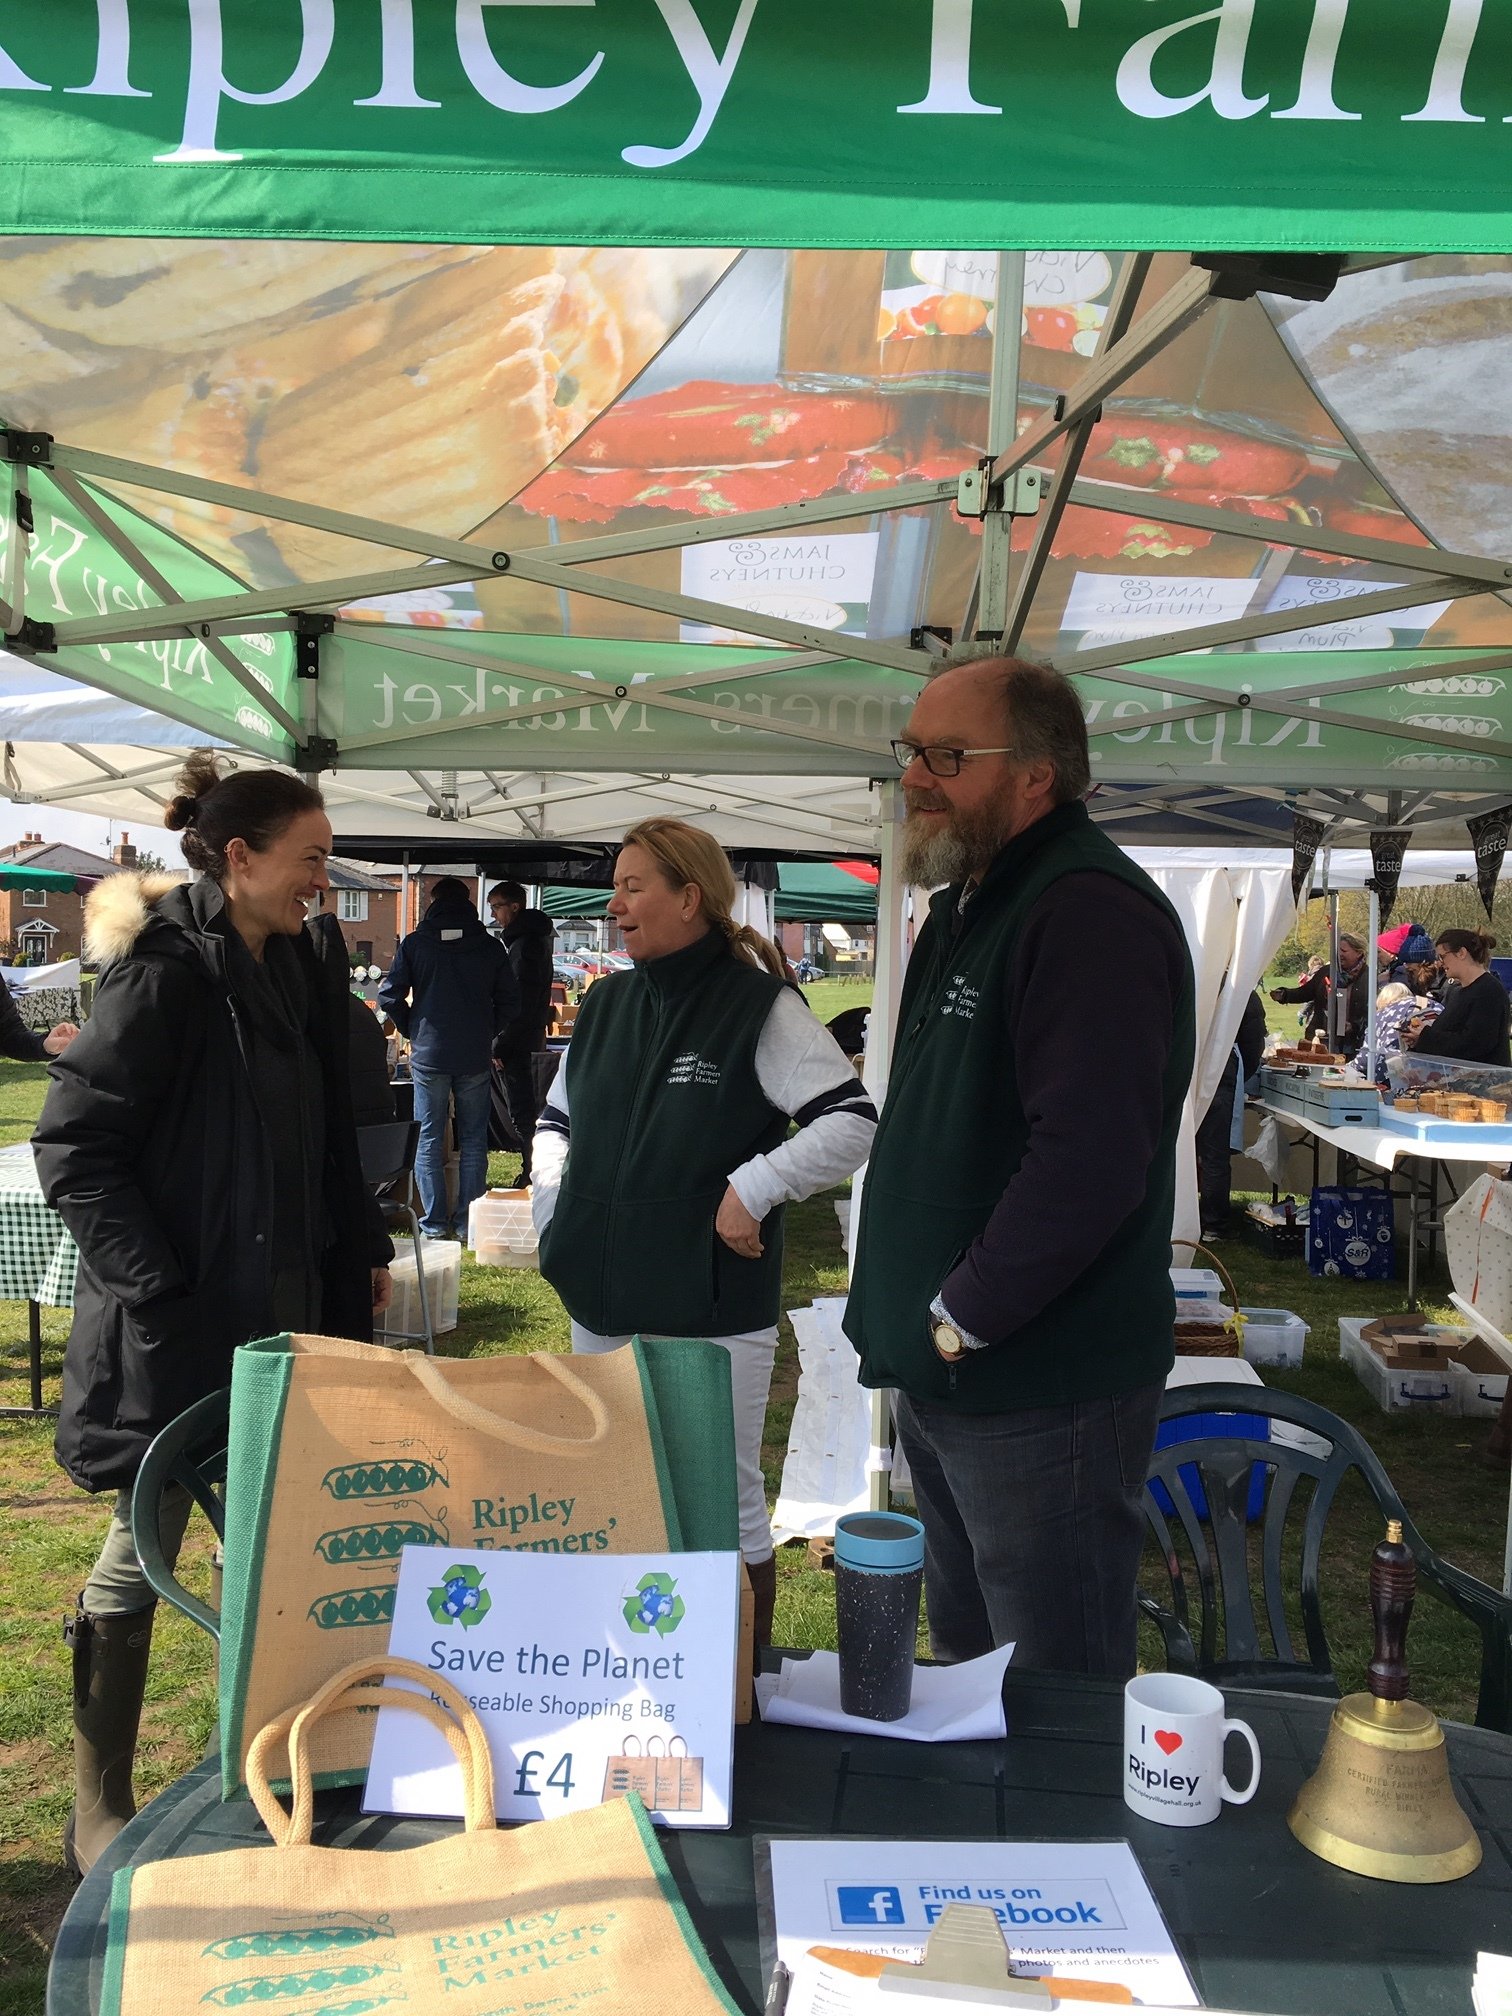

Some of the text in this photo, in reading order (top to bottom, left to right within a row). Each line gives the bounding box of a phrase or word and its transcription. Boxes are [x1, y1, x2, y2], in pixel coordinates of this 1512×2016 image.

[1295, 840, 1316, 857] taste
[1478, 838, 1507, 859] taste
[1376, 860, 1402, 872] taste
[697, 1060, 718, 1070] Ripley
[694, 1075, 718, 1085] Market
[472, 1493, 576, 1534] Ripley
[428, 1640, 685, 1679] Save the Planet
[430, 1691, 676, 1722] seable Shopping Bag
[1141, 1724, 1146, 1745] I
[513, 1750, 576, 1798] £4
[1129, 1753, 1201, 1796] Ripley
[919, 1886, 1042, 1899] Find us on
[924, 1901, 1102, 1924] Febook
[432, 1908, 560, 1954] Ripley
[893, 1946, 911, 1955] for
[1021, 1947, 1066, 1955] Market
[1068, 1947, 1092, 1955] and
[1096, 1947, 1126, 1955] then
[445, 1945, 601, 1992] Market
[1018, 1959, 1063, 1968] photos
[1094, 1958, 1160, 1966] anecdotes
